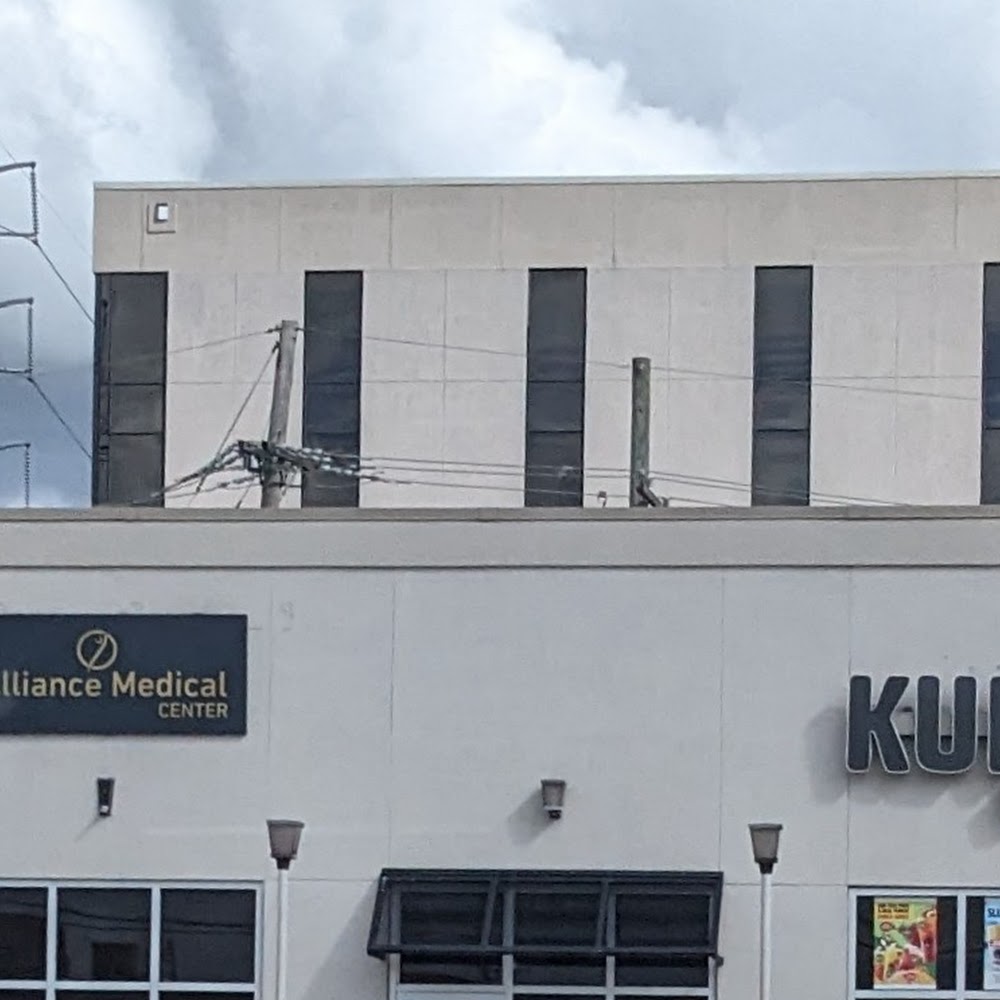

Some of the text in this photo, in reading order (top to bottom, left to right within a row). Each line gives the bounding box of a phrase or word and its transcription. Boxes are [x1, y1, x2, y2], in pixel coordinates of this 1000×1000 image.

[2, 670, 227, 698] lliance Medical
[158, 702, 228, 719] CENTER
